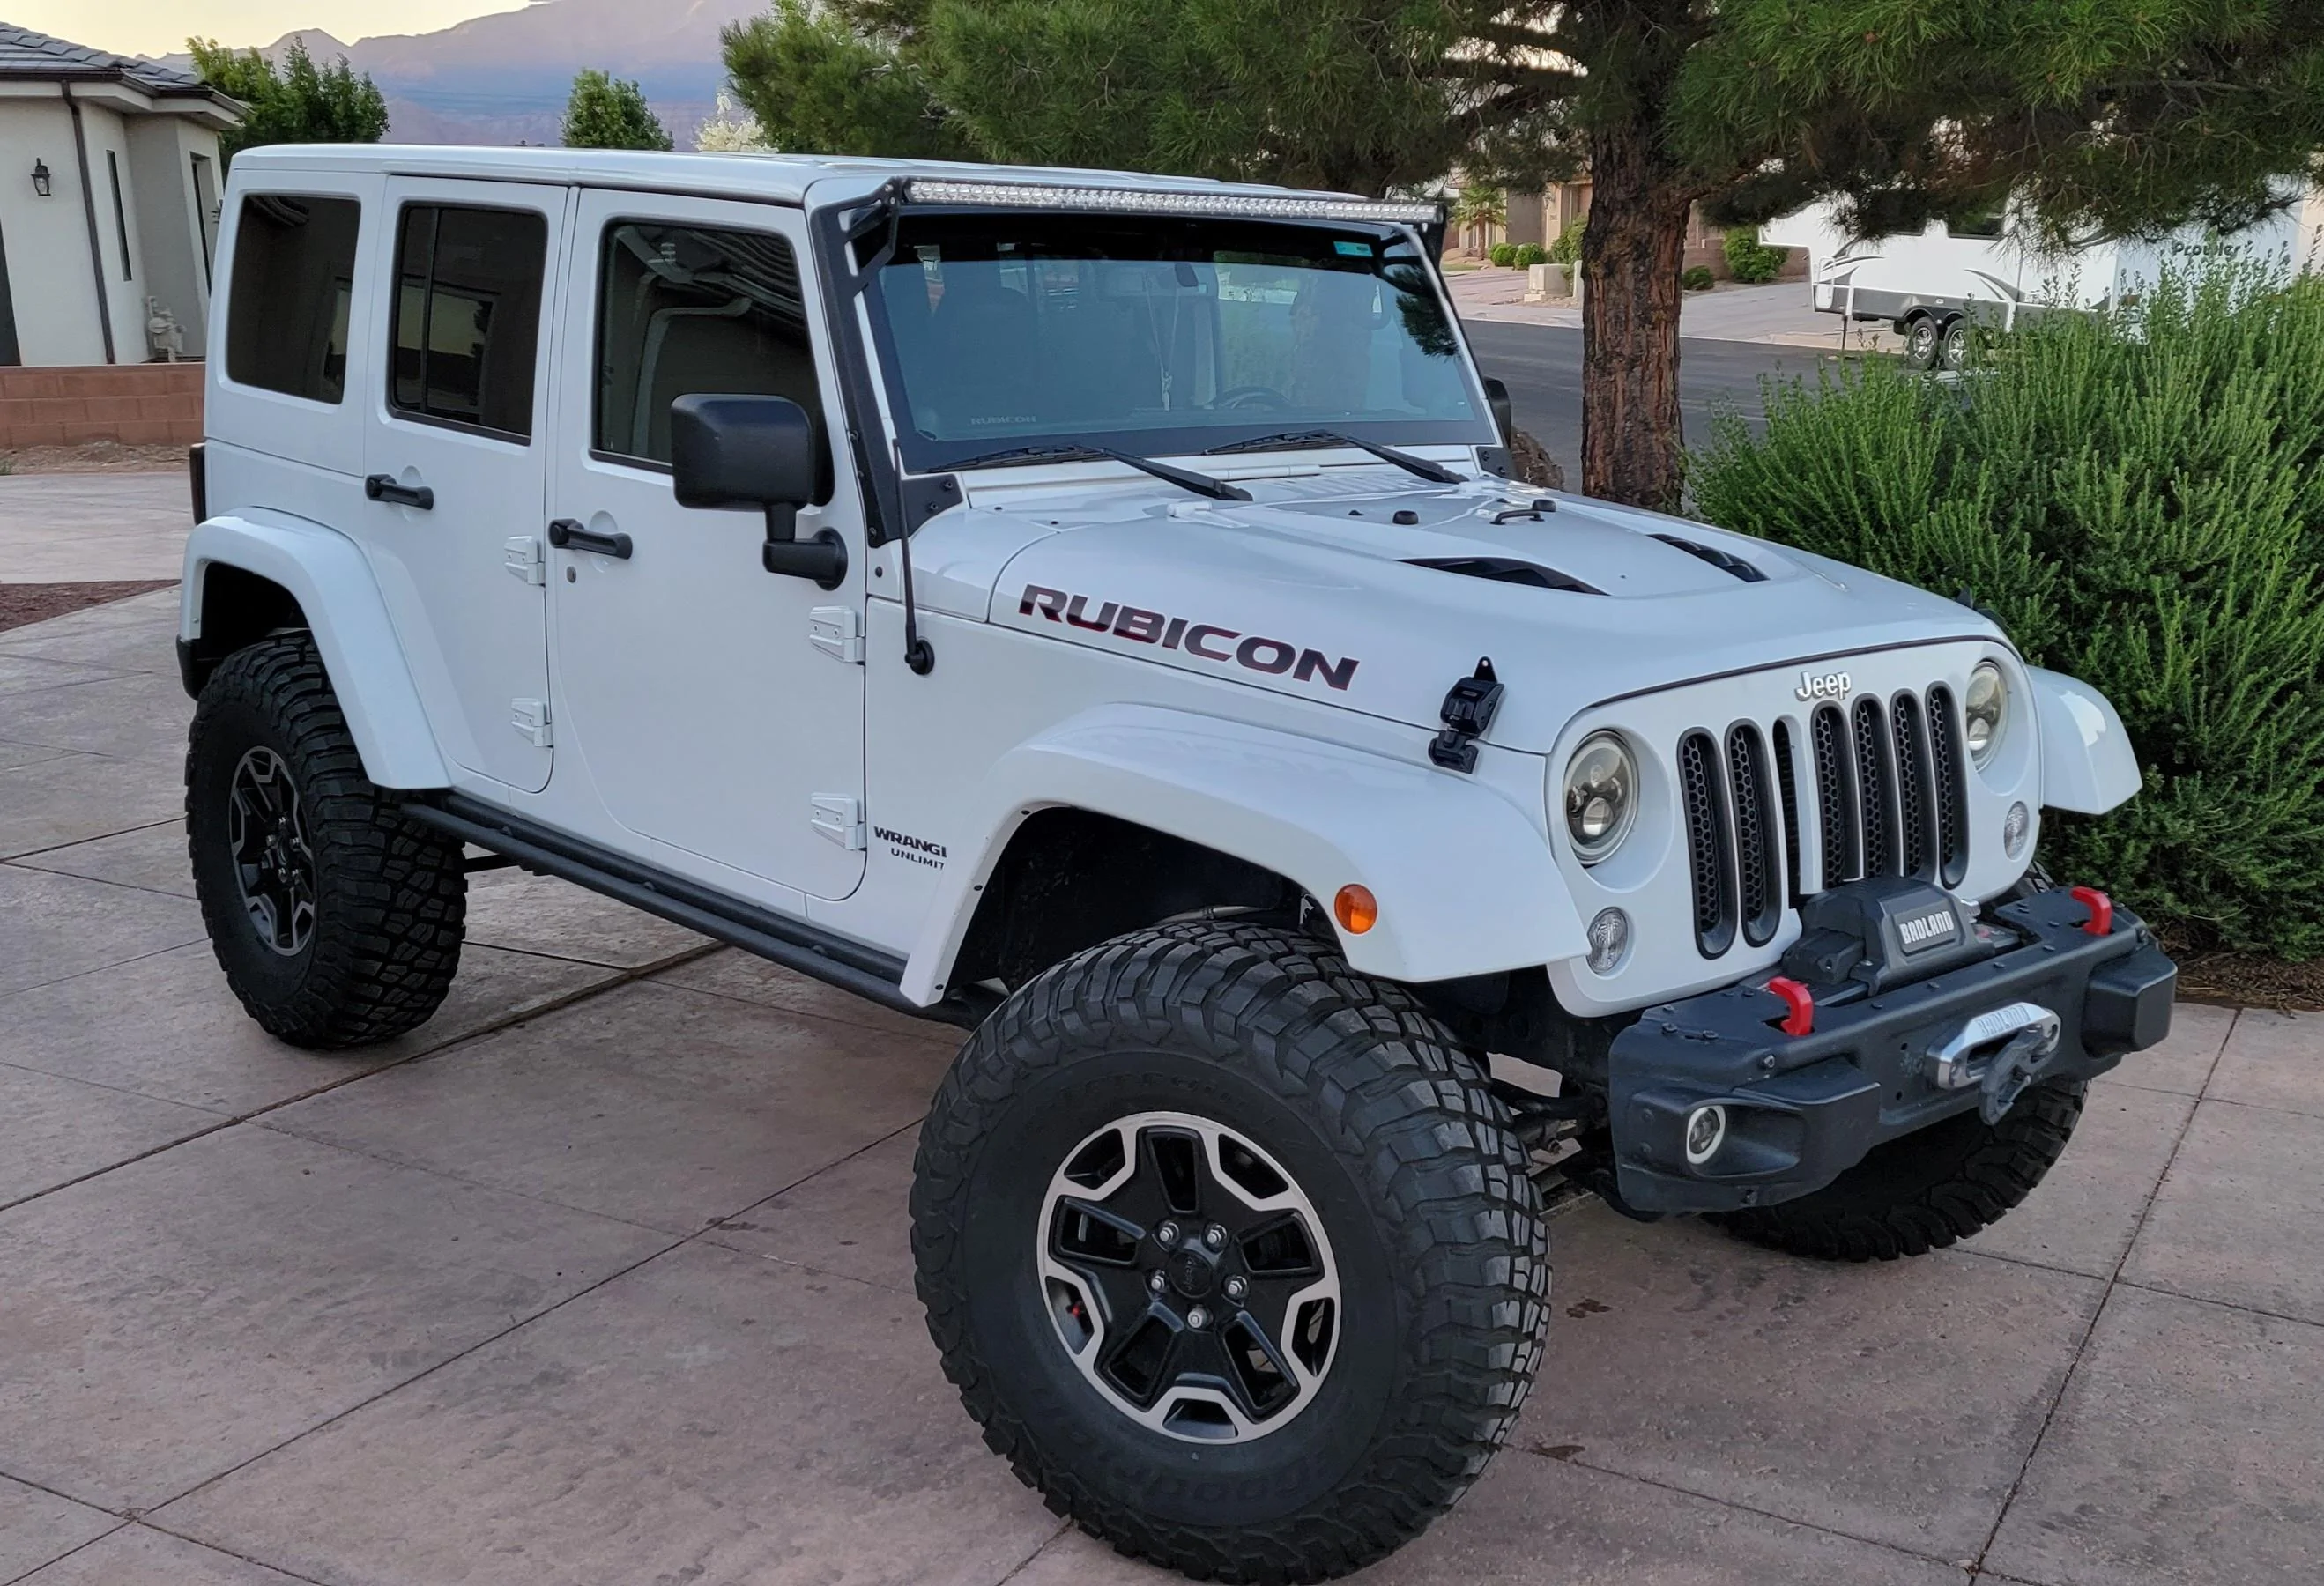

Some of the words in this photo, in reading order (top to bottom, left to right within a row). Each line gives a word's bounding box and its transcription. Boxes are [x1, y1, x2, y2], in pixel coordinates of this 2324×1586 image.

[970, 414, 1037, 426] RUBICON
[1018, 583, 1360, 692] RUBICON
[1794, 670, 1852, 702] Jeep
[1898, 910, 1955, 945] BADLAND
[1978, 1004, 2031, 1037] BADLAND
